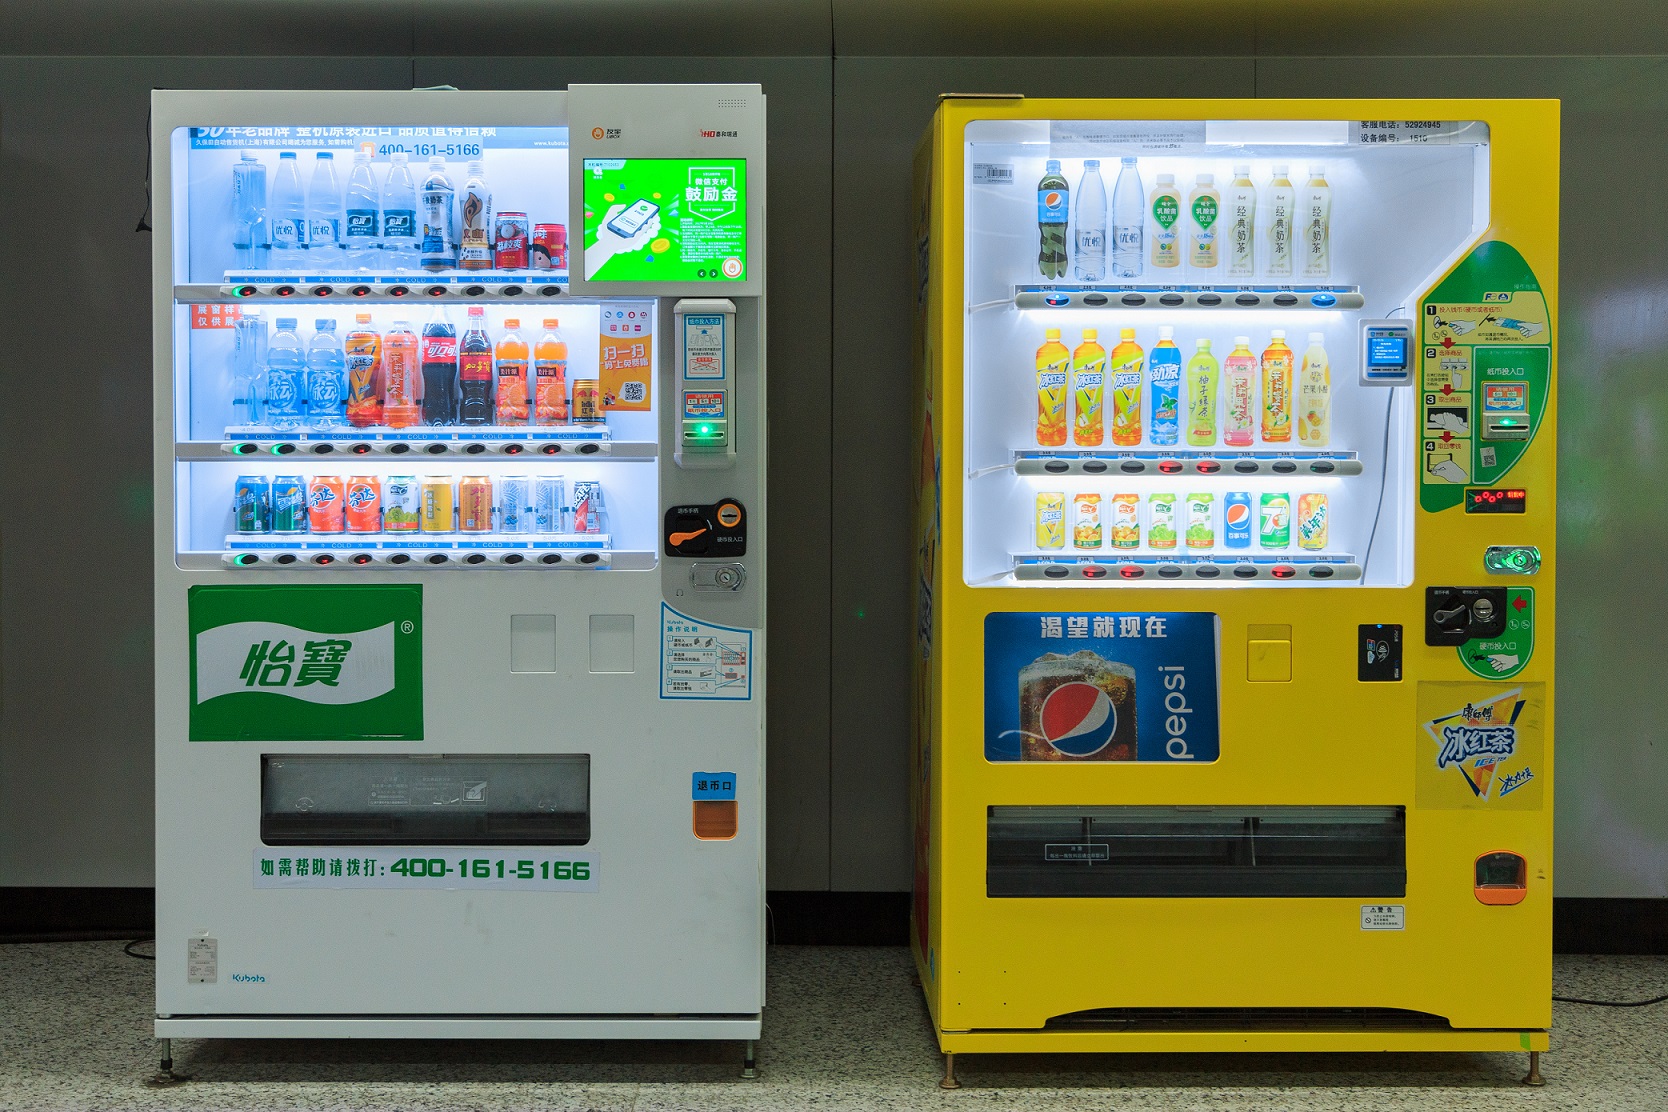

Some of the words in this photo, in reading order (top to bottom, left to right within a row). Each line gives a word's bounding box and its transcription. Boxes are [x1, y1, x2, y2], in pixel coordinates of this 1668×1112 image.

[379, 143, 480, 156] 400-161-5166
[695, 177, 728, 186] 微信支付
[685, 186, 738, 202] 鼓励金
[1236, 205, 1247, 254] 经典奶茶
[1275, 205, 1285, 254] 经典奶茶
[1312, 205, 1322, 254] 经典奶茶
[197, 316, 242, 327] 仅供展
[603, 343, 645, 361] 扫一扫
[1299, 505, 1328, 541] 美年达
[1040, 616, 1167, 639] 渴望就现在
[1480, 642, 1517, 650] 硬币投入口
[1158, 665, 1194, 759] pepsi
[1438, 726, 1515, 769] 冰红茶
[1474, 757, 1495, 768] ICE
[697, 780, 732, 791] 退币口
[232, 974, 265, 982] Kubota
